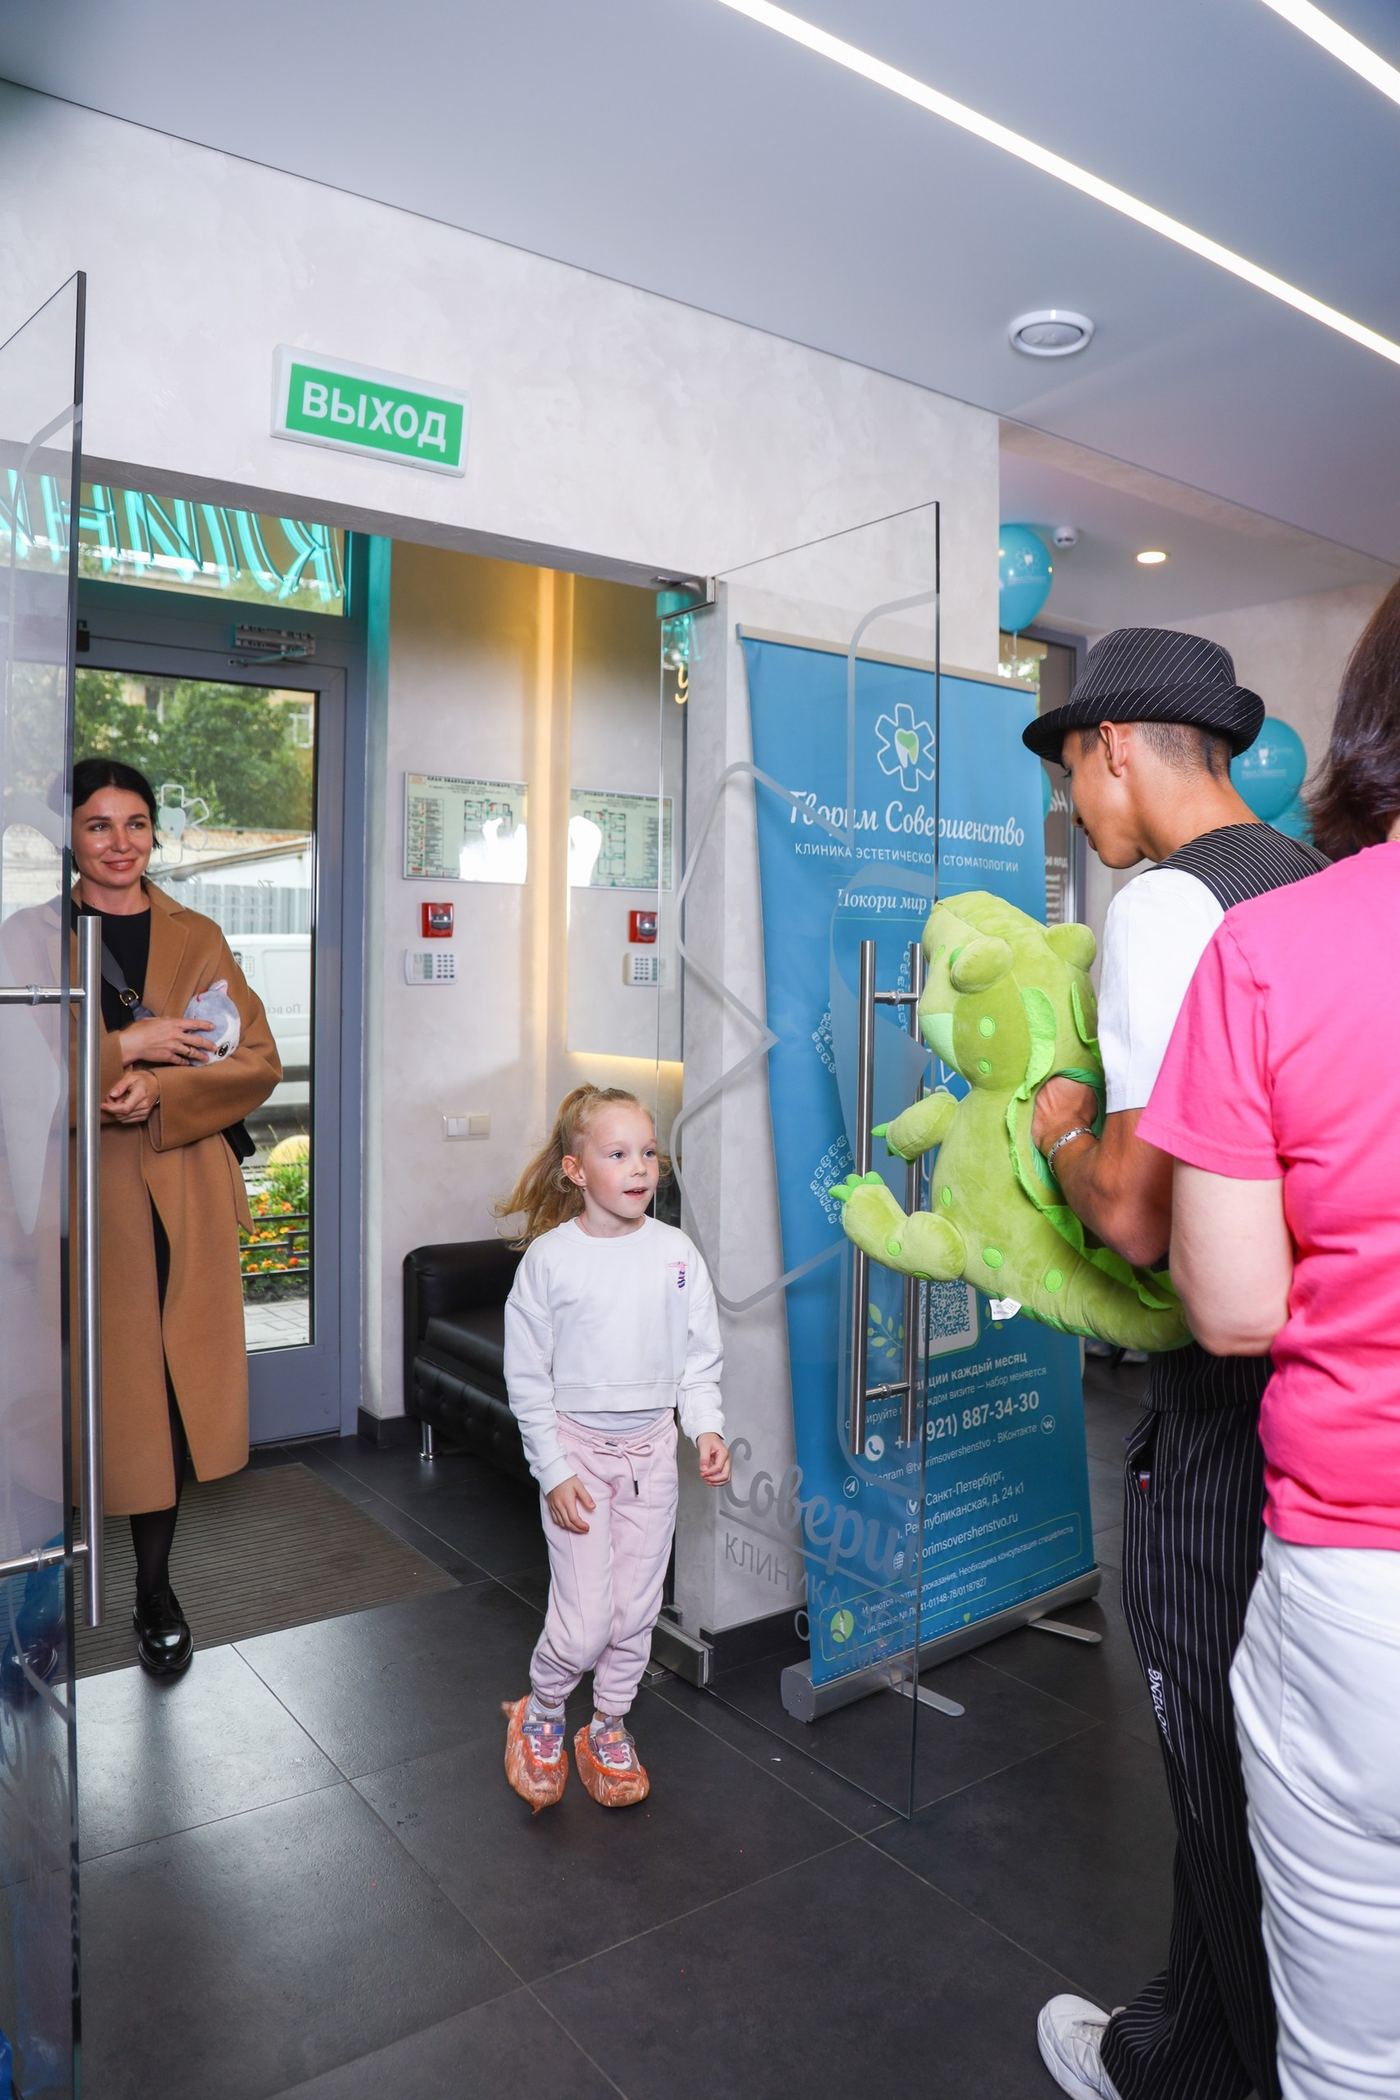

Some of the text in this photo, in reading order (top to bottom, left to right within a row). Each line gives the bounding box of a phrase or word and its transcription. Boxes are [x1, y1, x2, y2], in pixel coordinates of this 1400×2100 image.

[302, 380, 446, 453] ВЫХОД
[885, 800, 1025, 847] Совершенство
[795, 842, 852, 858] КЛИНИКА
[943, 855, 1019, 873] СТОМАТОЛОГИИ
[900, 897, 927, 916] мир
[951, 1362, 993, 1381] каждый
[994, 1352, 1027, 1370] месяц
[949, 1386, 976, 1400] визите
[986, 1375, 1008, 1389] набор
[1009, 1366, 1047, 1382] меняется
[962, 1391, 1040, 1430] 887-34-30
[997, 1424, 1037, 1444] ВКонтакте
[925, 1470, 1005, 1506] Санкт-Петербург,
[1002, 1485, 1012, 1500] 24
